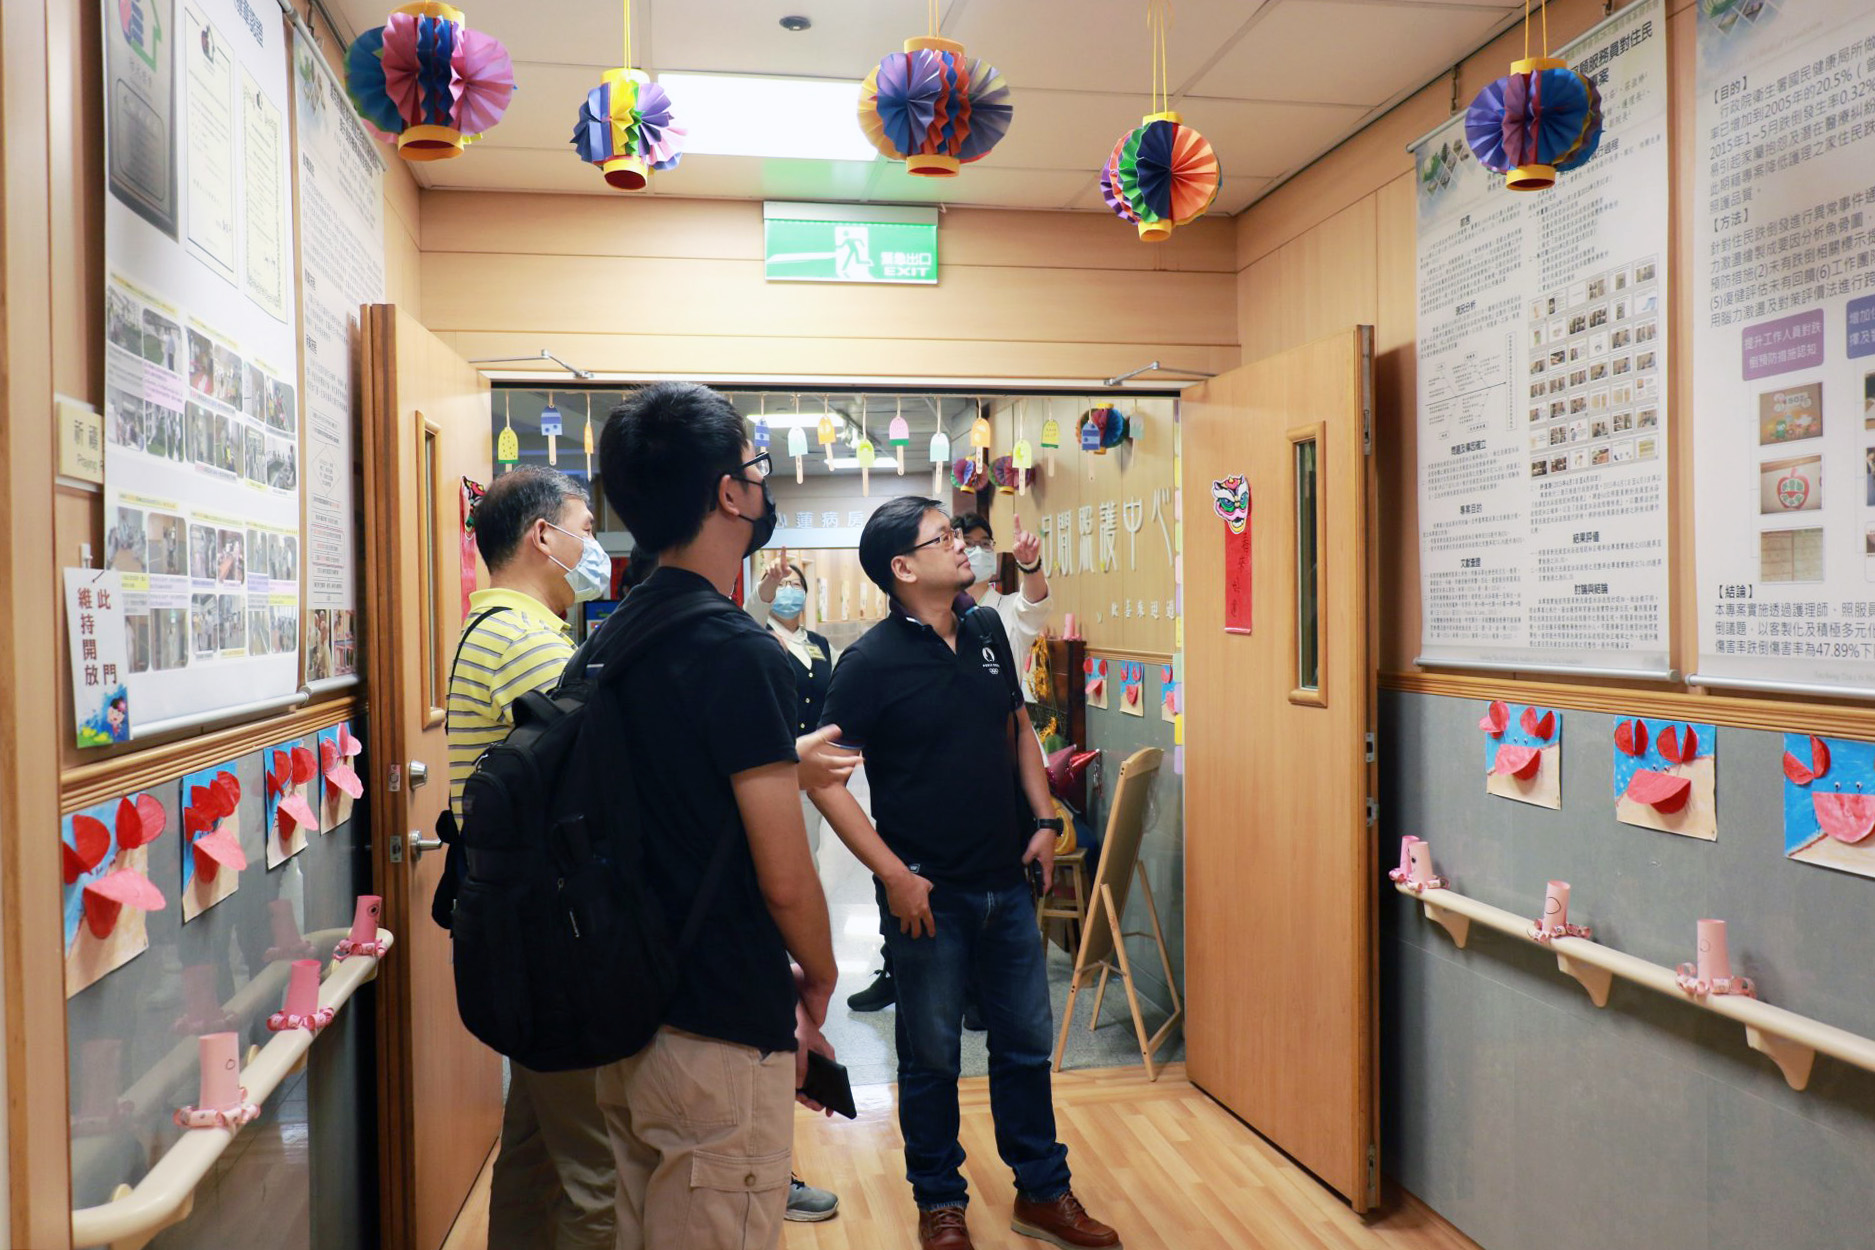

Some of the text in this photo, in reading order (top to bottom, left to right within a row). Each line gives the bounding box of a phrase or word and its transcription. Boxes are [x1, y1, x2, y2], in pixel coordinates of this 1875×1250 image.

[884, 267, 930, 276] EXIT
[1718, 584, 1753, 599] 【結論】
[77, 587, 98, 686] 維持開放
[1715, 640, 1875, 659] 傷害率跌倒傷害率為47.89%下
